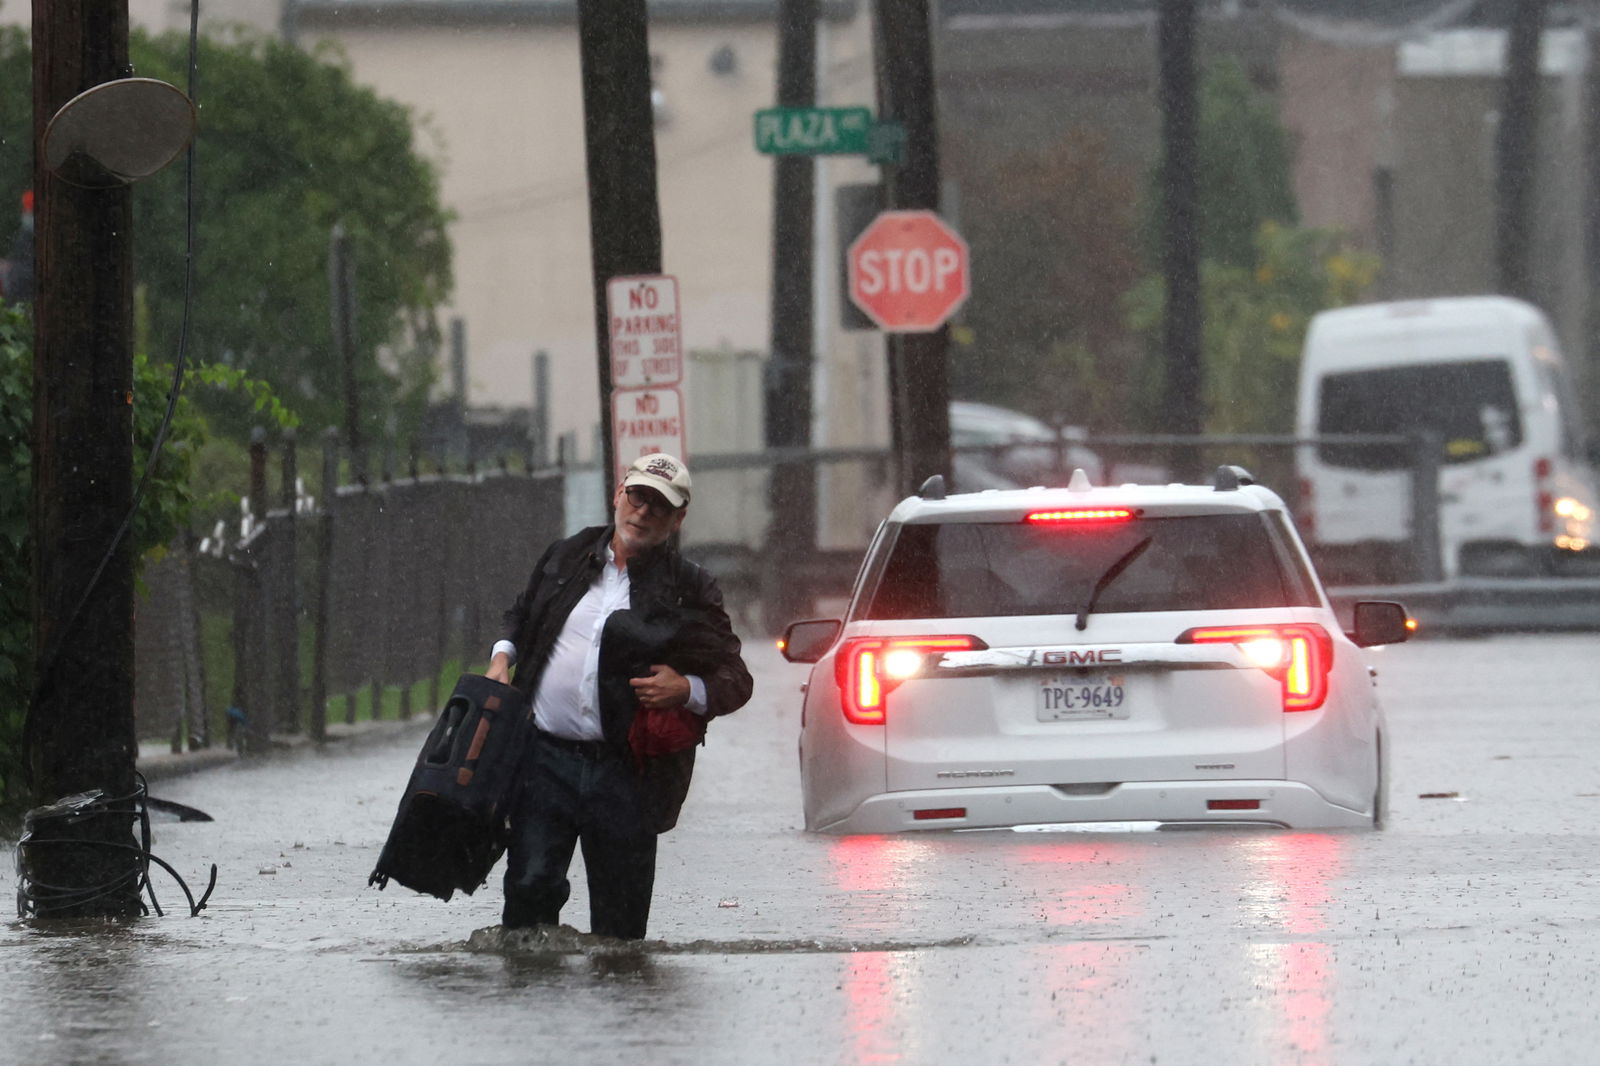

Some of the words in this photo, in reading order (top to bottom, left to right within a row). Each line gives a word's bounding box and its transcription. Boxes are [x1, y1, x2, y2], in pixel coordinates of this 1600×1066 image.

[759, 113, 839, 148] PLAZA
[860, 248, 959, 295] STOP
[629, 287, 659, 310] NO
[612, 315, 678, 336] PARKING
[635, 396, 660, 416] NO
[618, 417, 679, 438] PARKING
[1043, 649, 1122, 664] GMC
[1042, 686, 1124, 709] TPC-9649
